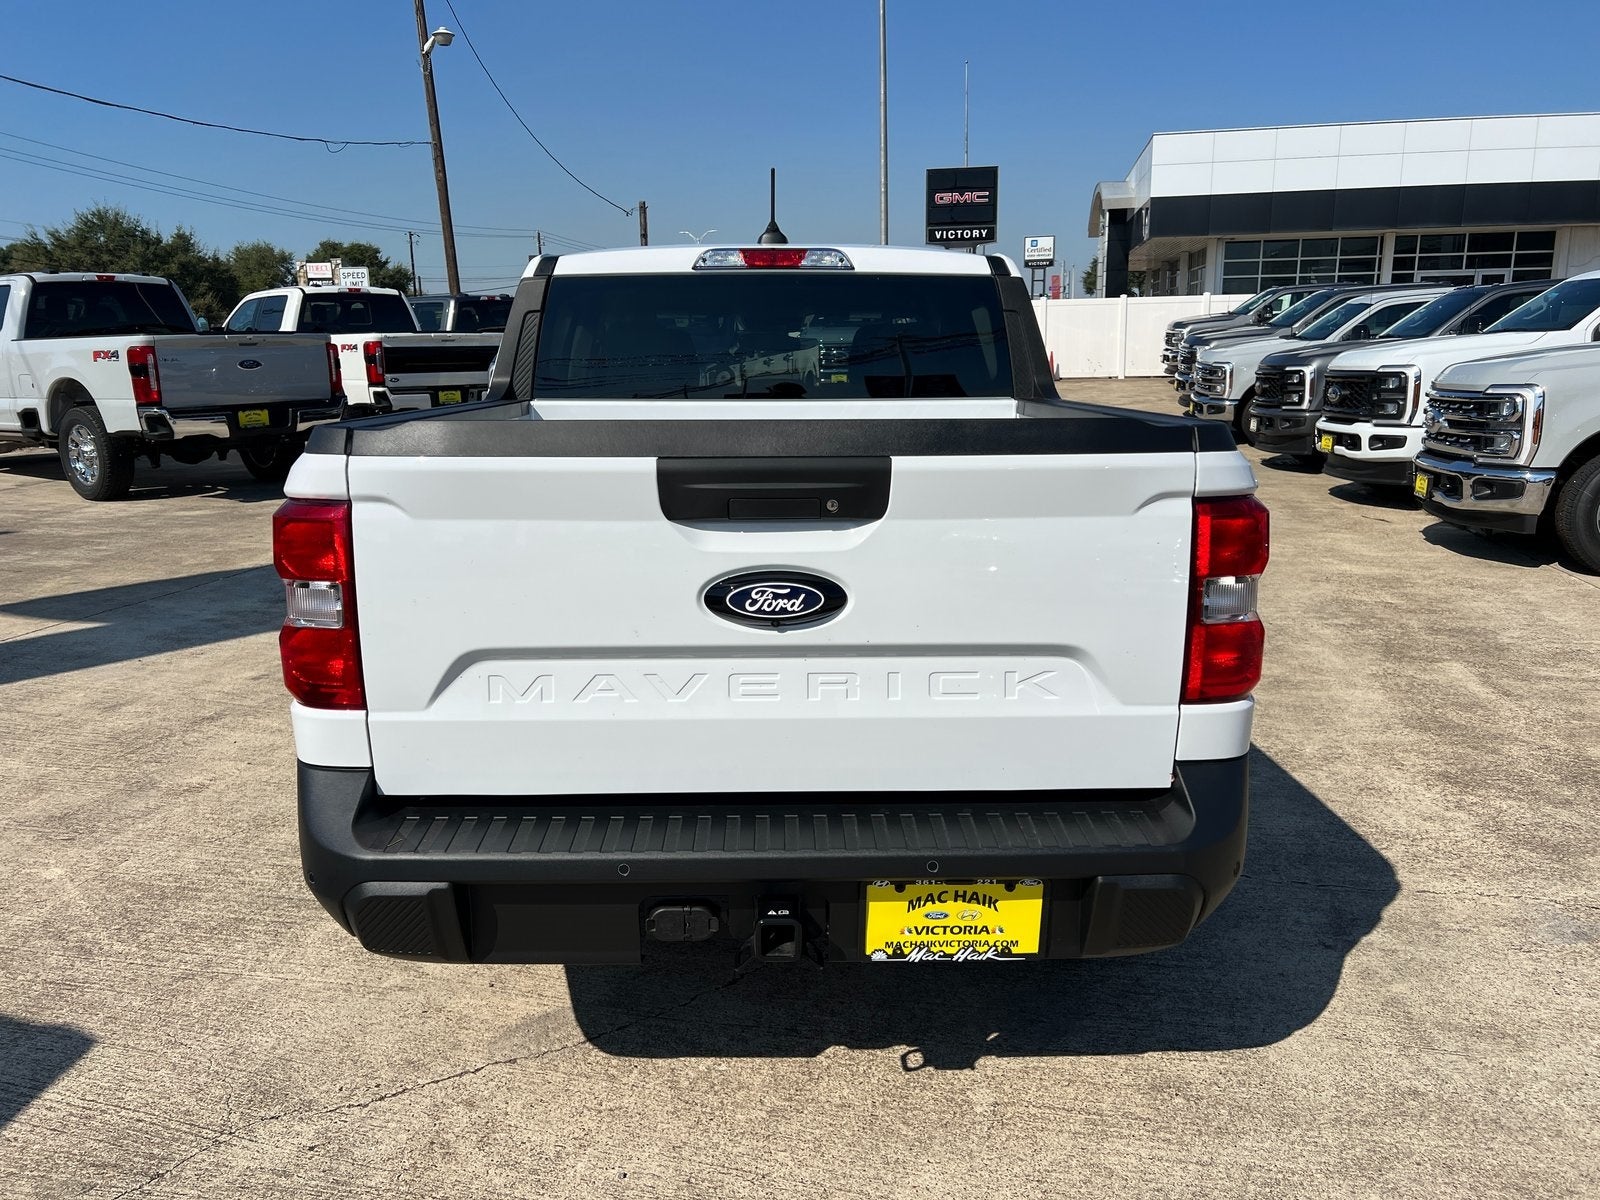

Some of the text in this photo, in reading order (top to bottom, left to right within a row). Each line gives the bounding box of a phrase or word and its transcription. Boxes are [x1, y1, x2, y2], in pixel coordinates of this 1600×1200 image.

[935, 191, 989, 205] GMC
[935, 229, 988, 240] VICTORY
[1026, 246, 1052, 254] Certified
[92, 349, 120, 363] FX4
[745, 587, 806, 612] Ford
[487, 671, 1061, 703] MAVERICK
[906, 890, 1001, 914] MAC HAIK
[914, 925, 991, 936] VICTORIA
[884, 939, 1019, 950] MACHAIKVICTORIA.COM
[905, 946, 1002, 962] Mac Haik
